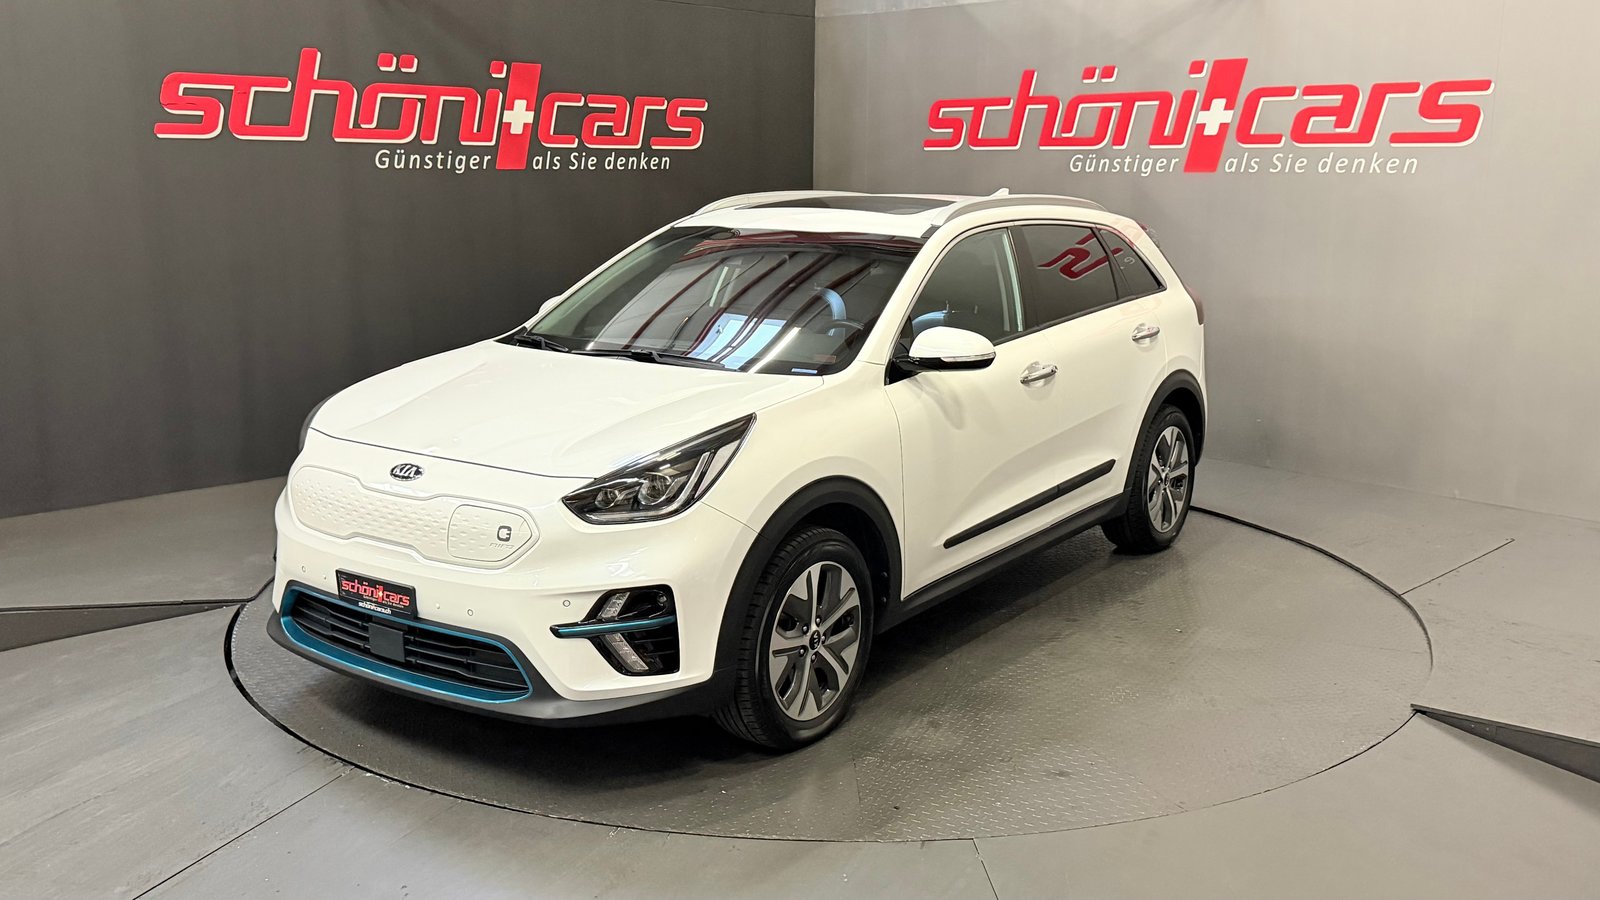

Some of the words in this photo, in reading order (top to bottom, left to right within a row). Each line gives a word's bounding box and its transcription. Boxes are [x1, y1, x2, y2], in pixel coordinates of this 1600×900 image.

[537, 92, 708, 149] cars
[1236, 79, 1495, 147] cars
[375, 150, 492, 173] Günstiger
[532, 151, 562, 171] als
[568, 151, 598, 172] Sie
[604, 151, 671, 171] denken
[1069, 153, 1180, 177] Günstiger
[1224, 152, 1260, 174] als
[1269, 152, 1308, 174] Sie
[1318, 150, 1418, 174] denken
[393, 464, 415, 479] KIA
